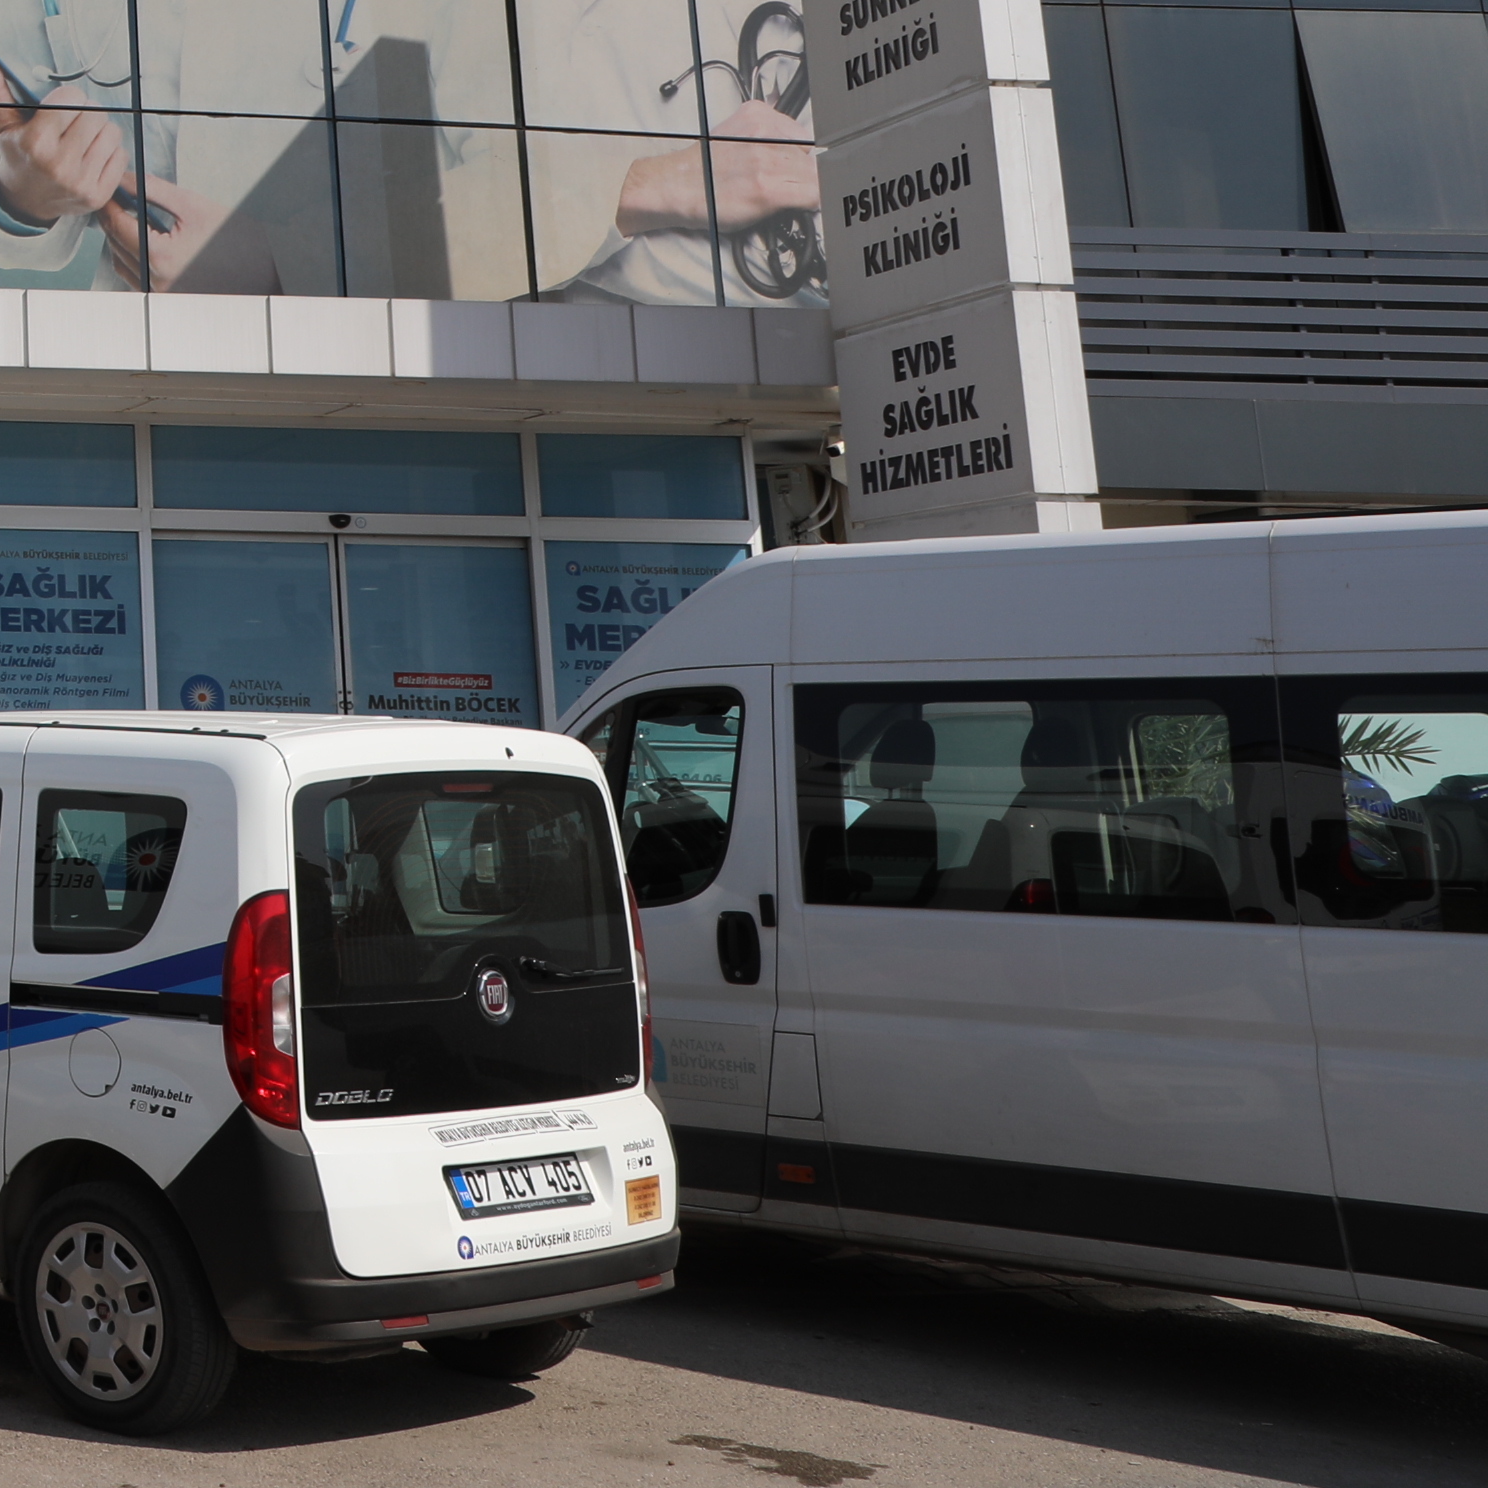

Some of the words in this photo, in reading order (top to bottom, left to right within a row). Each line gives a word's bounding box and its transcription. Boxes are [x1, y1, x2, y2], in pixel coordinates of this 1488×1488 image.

[844, 18, 940, 92] KLİNİĞİ
[842, 142, 972, 228] PSİKOLOJİ
[862, 209, 961, 279] KLİNİĞİ
[891, 333, 958, 384] EVDE
[881, 384, 980, 439] SAĞLIK
[859, 425, 1015, 496] HİZMETLERİ
[23, 549, 80, 560] BÜYÜKŞEHİR
[83, 551, 129, 561] BELEDİYESİ
[582, 565, 620, 573] ANTALYA
[623, 564, 679, 575] BÜYÜKŞEHİR
[16, 645, 29, 654] ve
[32, 643, 52, 655] DİŞ
[55, 644, 104, 655] SAĞLIĞI
[20, 673, 32, 681] ve
[35, 672, 53, 683] Diş
[56, 674, 113, 684] Muayenesi
[229, 679, 284, 691] ANTALYA
[53, 686, 99, 698] Röntgen
[102, 687, 130, 698] Filmi
[229, 691, 312, 709] BÜYÜKŞEHİR
[368, 694, 451, 712] Muhittin
[455, 692, 522, 713] BÖCEK
[13, 699, 51, 710] Çekimi
[486, 984, 503, 1005] FIAT
[669, 1038, 726, 1053] ANTALYA
[670, 1053, 757, 1075] BÜYÜKŞEHİR
[131, 1083, 193, 1104] antalya.bel.tr
[315, 1089, 394, 1107] DOBLO
[623, 1137, 655, 1153] antalya.bel.tr
[464, 1168, 491, 1204] 07
[497, 1164, 537, 1200] ACV
[540, 1159, 583, 1194] 405
[473, 1240, 515, 1258] ANTALYA
[516, 1228, 572, 1251] BÜYÜKŞEHİR
[573, 1223, 613, 1244] BELEDİYESİ
